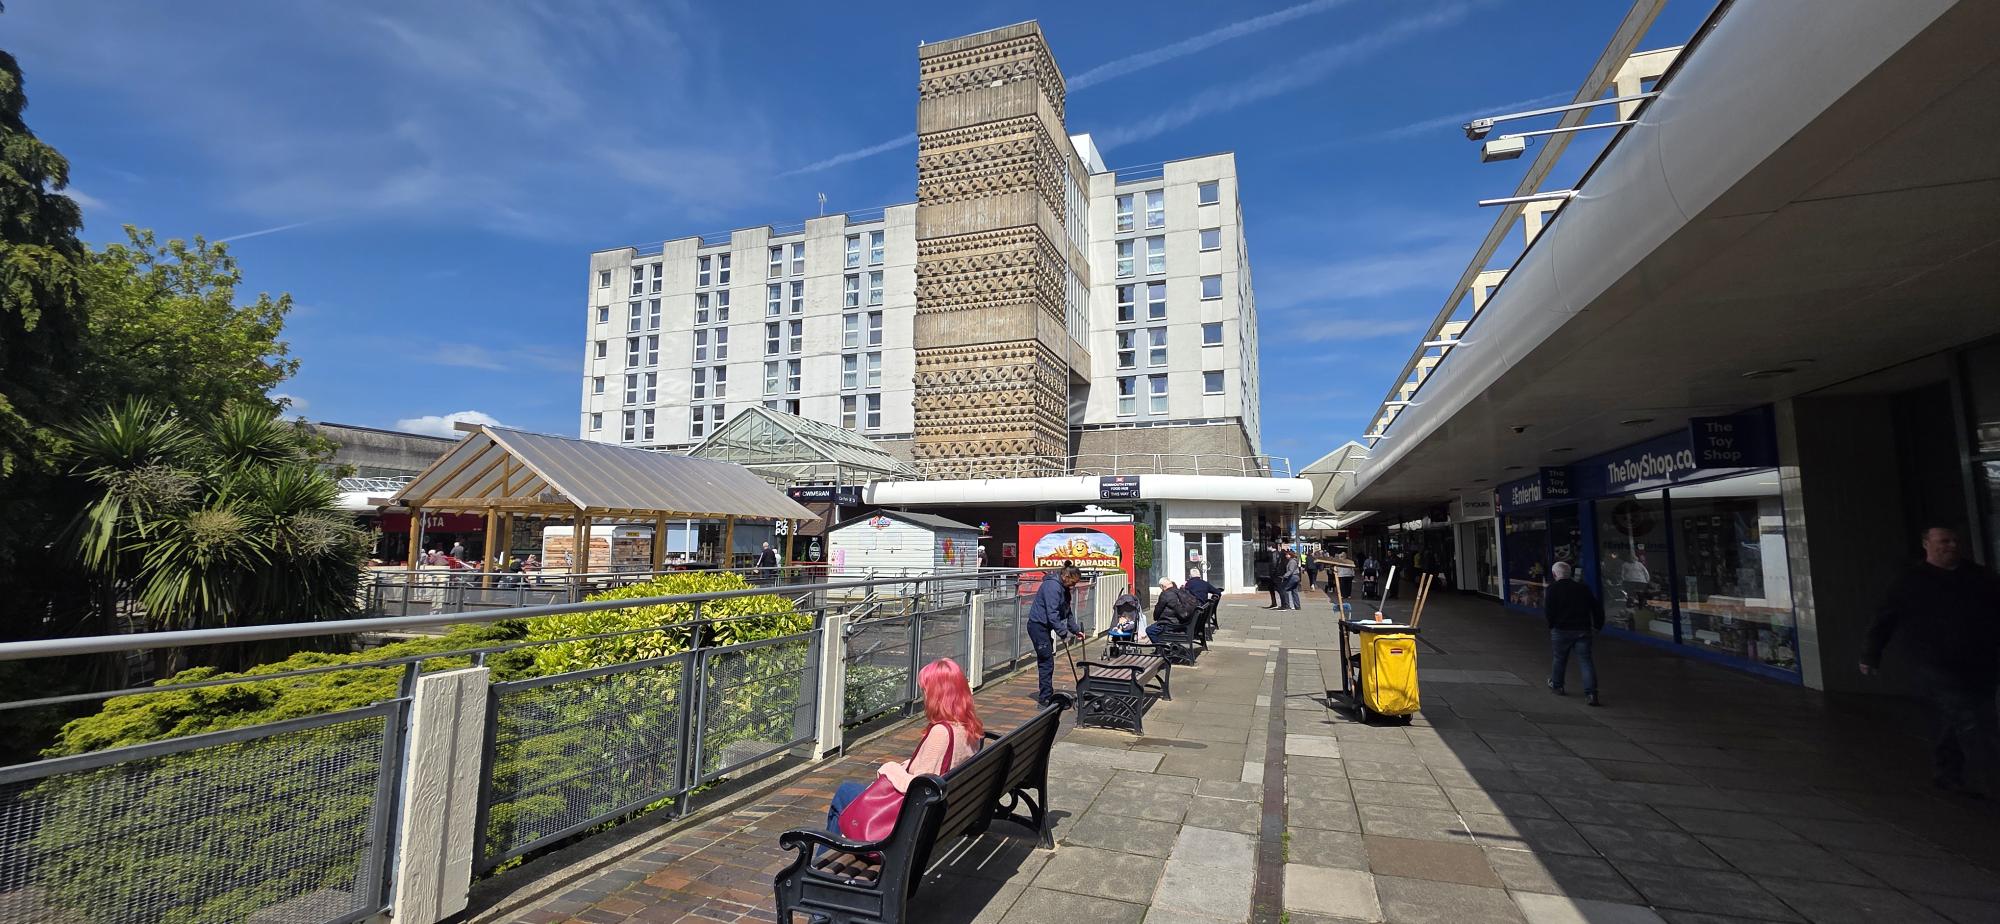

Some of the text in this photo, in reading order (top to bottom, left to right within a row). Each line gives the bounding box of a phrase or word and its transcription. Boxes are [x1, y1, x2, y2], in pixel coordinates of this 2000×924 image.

[1704, 422, 1733, 433] The
[1708, 436, 1734, 449] Toy
[1703, 449, 1742, 462] Shop
[1607, 449, 1696, 484] TheToyShop.co
[1550, 478, 1565, 486] Toy
[1546, 487, 1569, 495] Shop
[419, 516, 444, 529] OSTA
[1074, 559, 1117, 568] PARADISE
